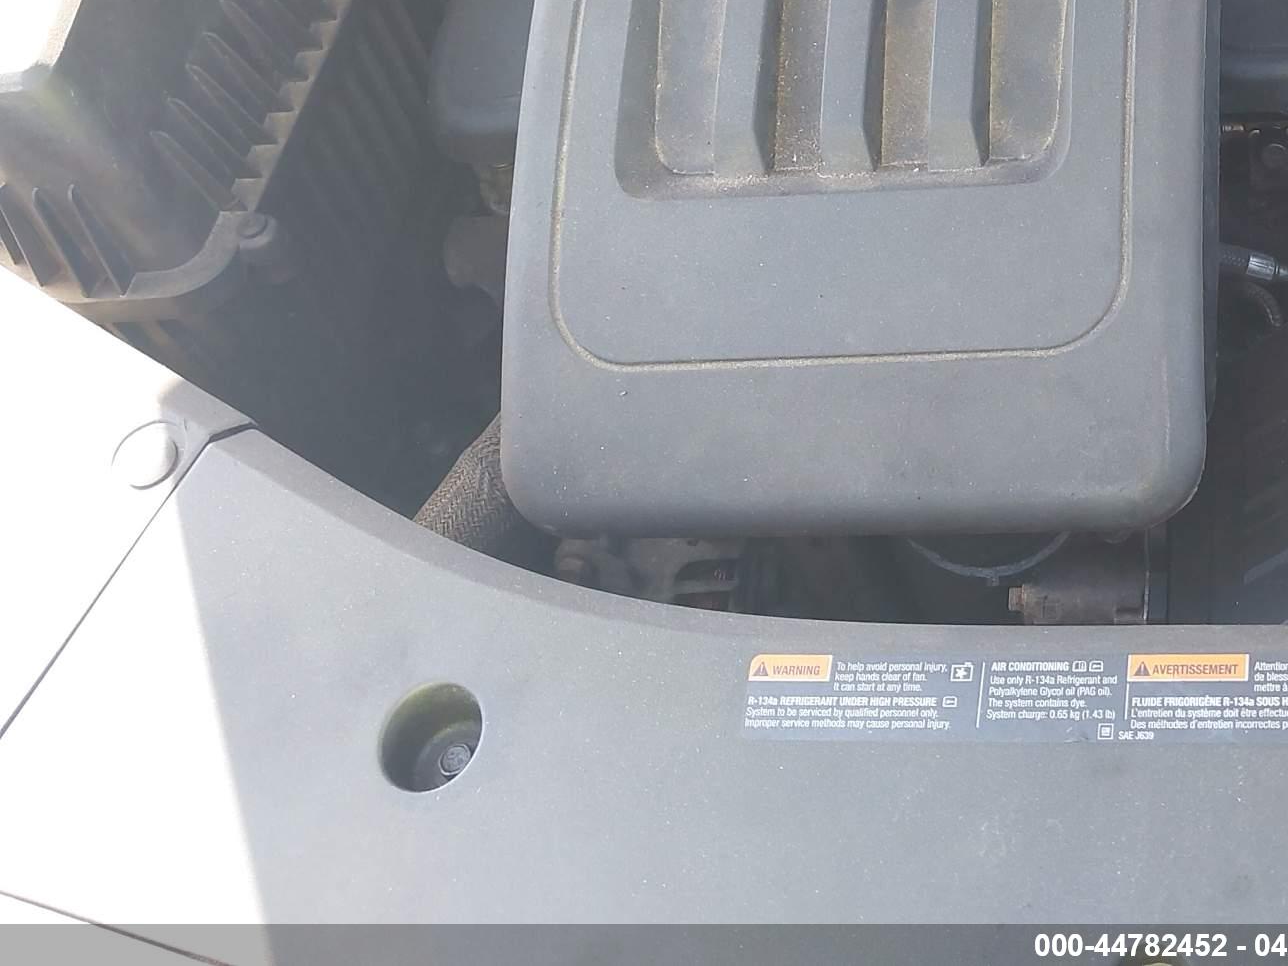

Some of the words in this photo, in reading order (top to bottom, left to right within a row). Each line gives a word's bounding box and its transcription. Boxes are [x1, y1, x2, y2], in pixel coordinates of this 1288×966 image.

[773, 665, 820, 675] WARNING
[837, 661, 846, 670] To
[847, 661, 864, 672] help
[866, 661, 887, 670] avoid
[888, 662, 922, 673] personal
[991, 661, 1006, 671] AIR
[1008, 661, 1070, 671] CONDITIONING
[1152, 664, 1238, 675] AVERTISSEMENT
[834, 671, 854, 682] keep
[855, 672, 880, 680] hands
[881, 672, 900, 681] clear
[902, 672, 910, 681] of
[989, 675, 1005, 684] Use
[1006, 675, 1023, 686] only
[1024, 675, 1055, 684] R-134a
[1056, 675, 1100, 686] Refrigerant
[1102, 675, 1117, 684] and
[1254, 672, 1264, 681] de
[833, 682, 839, 690] It
[856, 682, 875, 691] start
[876, 682, 885, 691] at
[886, 684, 901, 693] any
[988, 686, 1038, 697] Polyalkylene
[1039, 686, 1063, 697] Glycol
[1065, 686, 1075, 695] oil
[1076, 686, 1096, 697] (PAG
[1253, 682, 1280, 691] mettre
[1282, 682, 1288, 691] à
[748, 696, 778, 705] R-134a
[779, 696, 837, 705] REFRIGERANT
[839, 696, 868, 706] UNDER
[869, 696, 891, 706] HIGH
[892, 696, 937, 706] PRESSURE
[988, 698, 1003, 707] The
[1004, 698, 1033, 709] system
[1034, 698, 1068, 707] contains
[1132, 696, 1162, 706] FLUIDE
[1163, 694, 1221, 706] FRIGORIGÈNE
[1222, 696, 1254, 706] R-134a
[1256, 696, 1280, 706] SOUS
[745, 707, 775, 718] System
[776, 707, 785, 716] to
[786, 707, 797, 716] be
[798, 707, 832, 716] serviced
[832, 707, 843, 718] by
[844, 707, 878, 718] qualified
[879, 708, 919, 719] personnel
[986, 709, 1016, 720] System
[1017, 709, 1047, 720] charge:
[1048, 709, 1068, 718] 0.65
[1069, 709, 1080, 720] kg
[1081, 709, 1103, 720] (1.43
[1104, 709, 1115, 720] lb)
[1130, 708, 1173, 717] L'entretien
[1174, 708, 1186, 717] du
[1187, 708, 1221, 719] système
[1222, 708, 1239, 717] doit
[1240, 708, 1257, 717] être
[744, 718, 779, 729] Improper
[781, 718, 809, 727] service
[811, 718, 845, 727] methods
[846, 720, 864, 729] may
[890, 719, 925, 730] personal
[1130, 719, 1146, 728] Des
[1147, 719, 1188, 728] méthodes
[1189, 719, 1233, 728] d'entretien
[1234, 719, 1280, 728] incorrectes
[1118, 730, 1133, 739] SAE
[1136, 730, 1154, 739] J639
